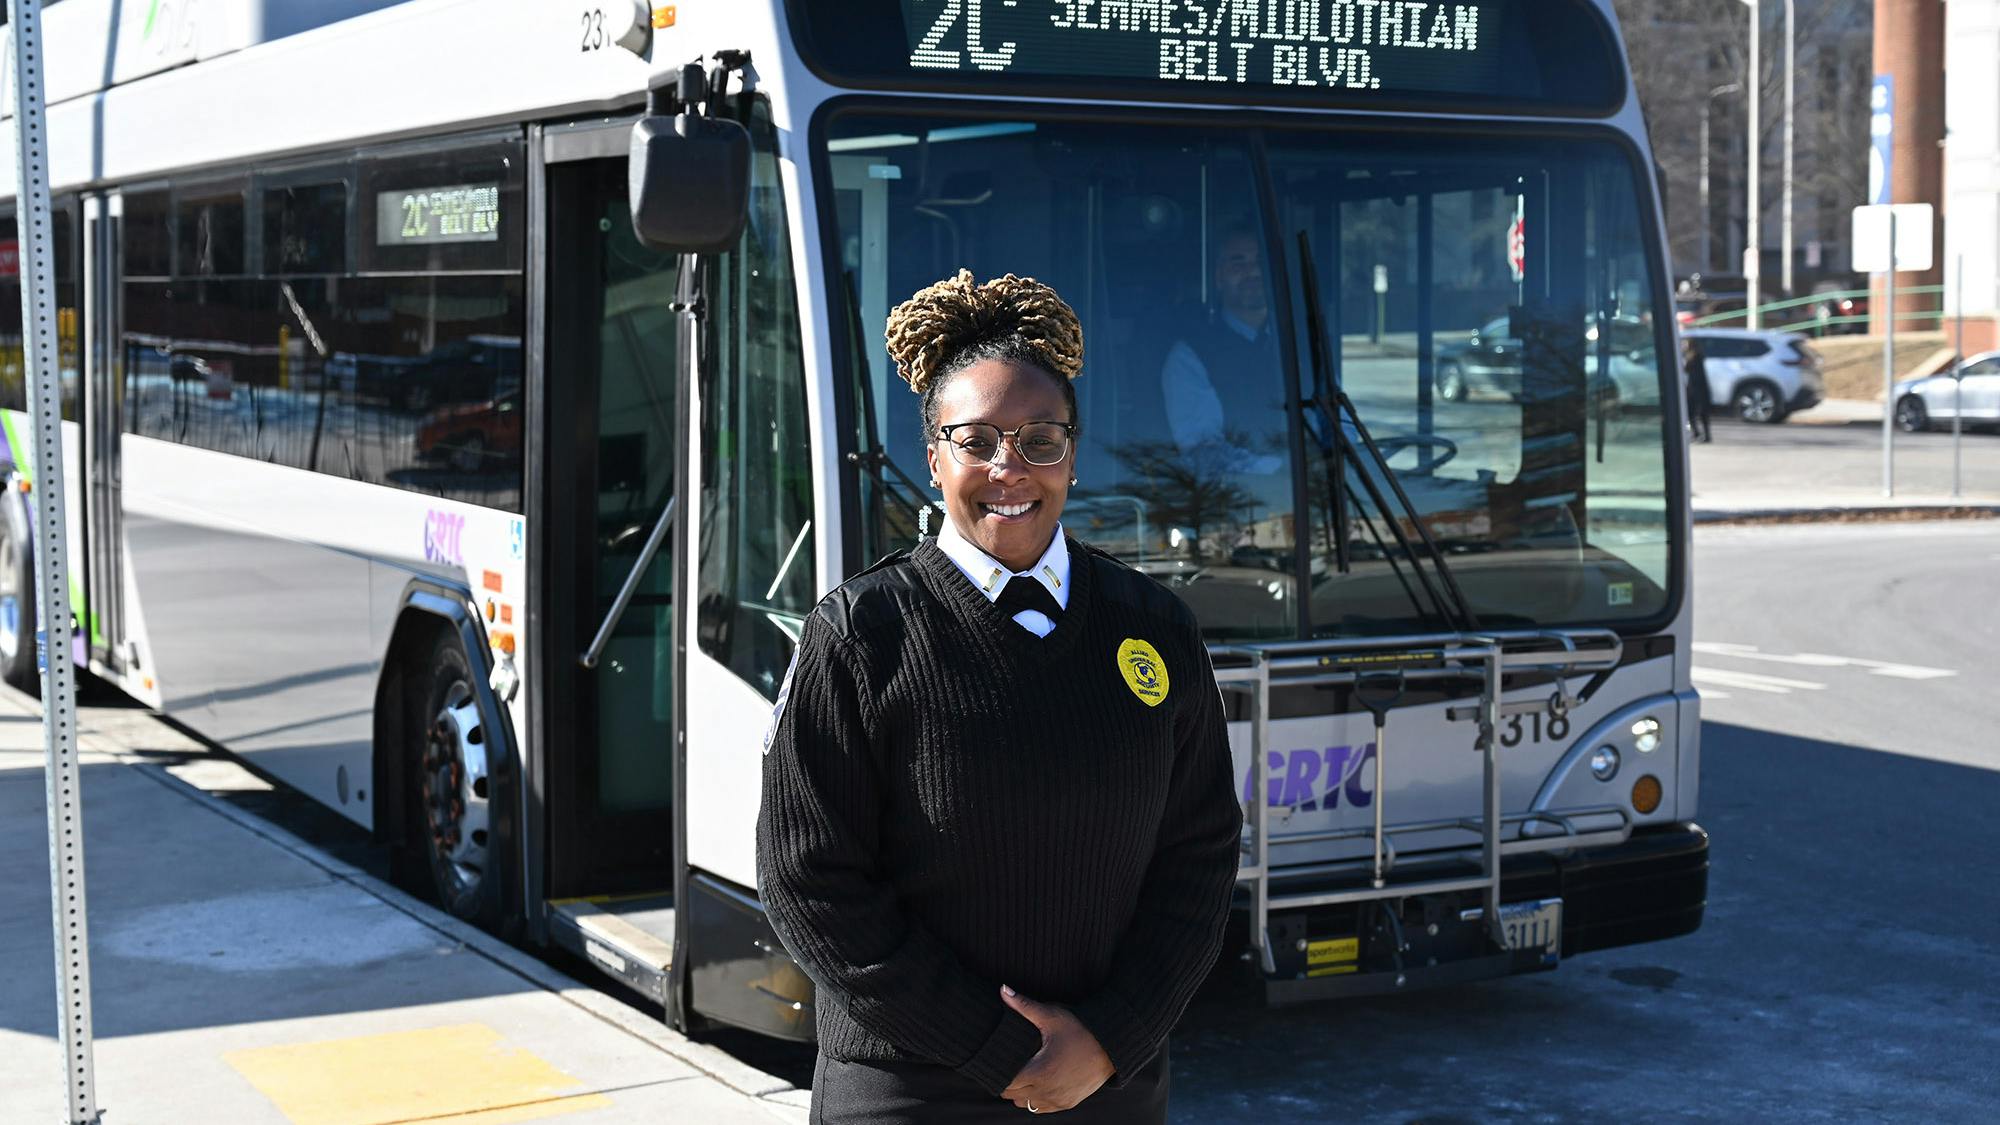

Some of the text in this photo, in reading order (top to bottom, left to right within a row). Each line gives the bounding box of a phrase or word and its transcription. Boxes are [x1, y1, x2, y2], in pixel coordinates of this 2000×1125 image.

[910, 0, 1017, 71] 2C
[1050, 0, 1479, 50] SEMMES/MIDLOTHIAN
[1160, 39, 1381, 89] BELT BLVD.
[402, 194, 428, 236] 2C
[425, 509, 466, 568] GRTC
[1243, 742, 1377, 813] GRTC
